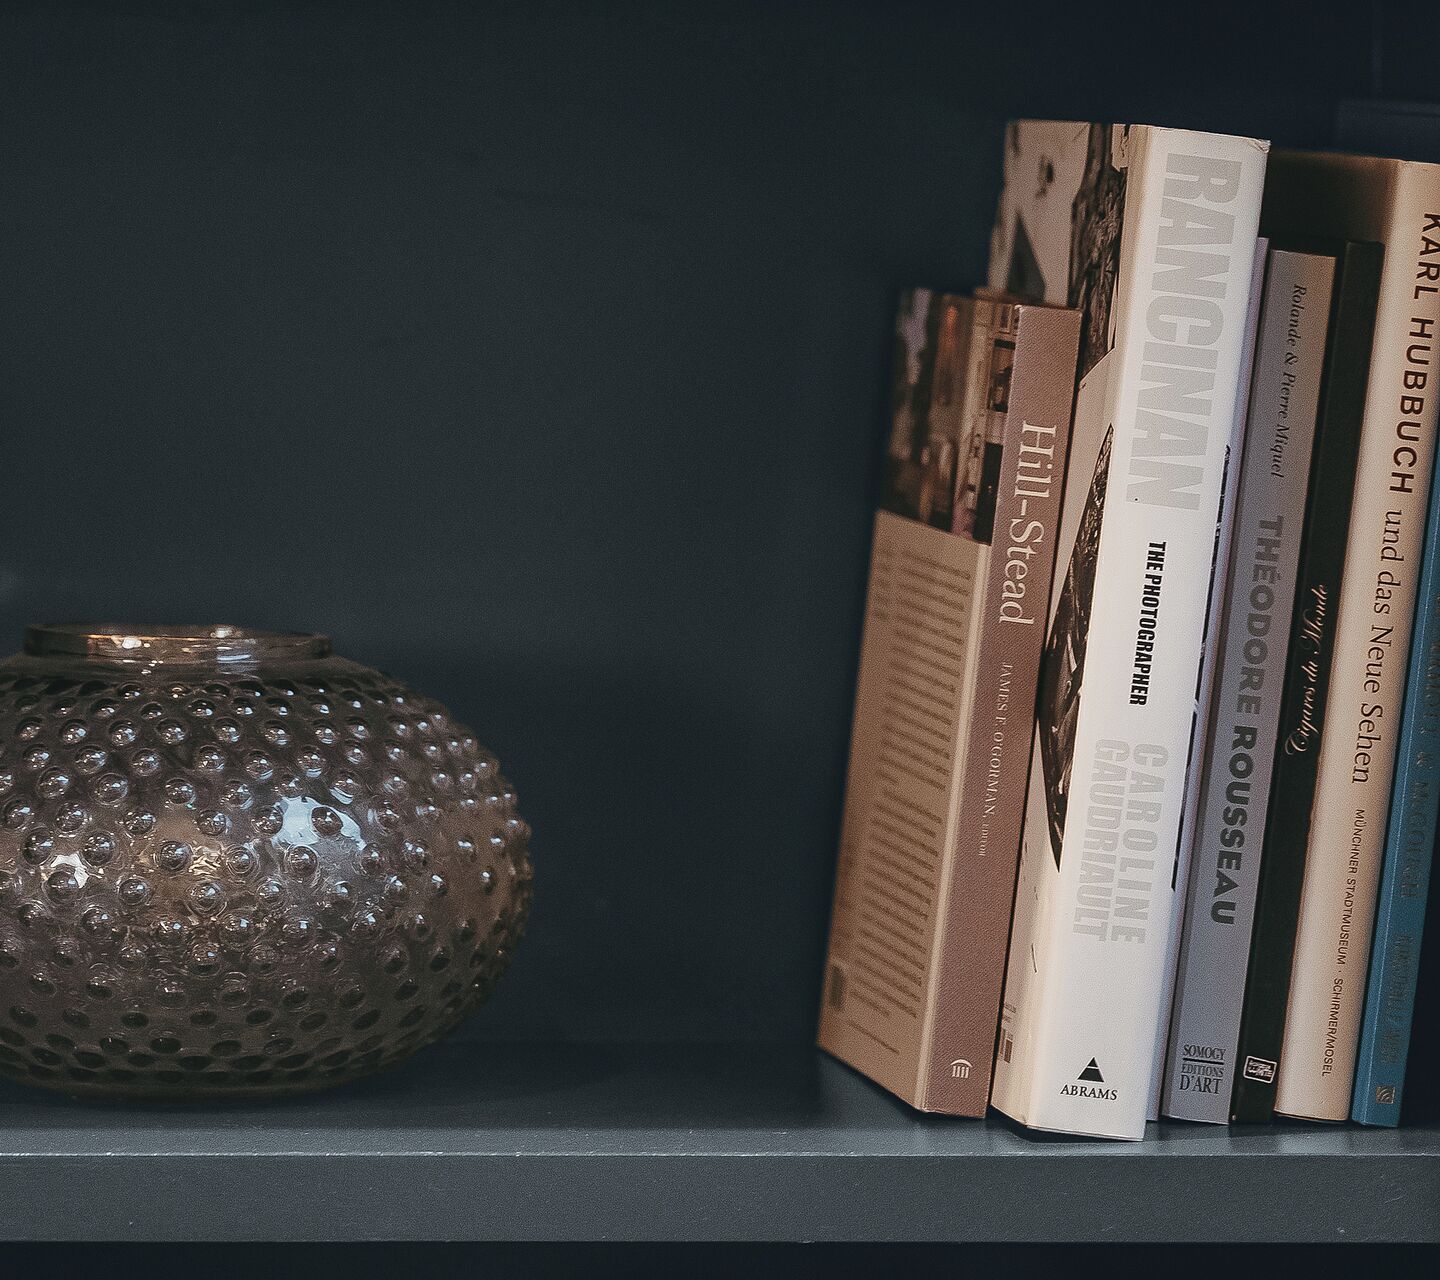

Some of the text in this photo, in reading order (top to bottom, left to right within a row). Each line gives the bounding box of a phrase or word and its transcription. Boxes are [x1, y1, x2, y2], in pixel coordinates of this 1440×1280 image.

[1125, 152, 1243, 511] RANCINAN
[1270, 283, 1308, 478] Rolande & Pierre Miquel
[998, 419, 1057, 626] Hill-Stead
[1352, 212, 1440, 784] KARL HUBBUCH und das Neue Sehen
[996, 662, 1014, 711] JAMES
[1128, 541, 1167, 707] THE PHOTOGRAPHER
[1210, 515, 1284, 926] THÉODORE ROUSSEAU
[1284, 584, 1329, 756] Cigares du Monde
[1072, 738, 1132, 942] GAUDRIAULT
[1111, 743, 1170, 945] CAROLINE
[1321, 809, 1366, 1078] MÜNCHNER STADTMUSEUM SCHIRMER/MOSEL
[1060, 1084, 1118, 1101] ABRAMS
[1179, 1078, 1222, 1095] D'ART
[1182, 1043, 1226, 1061] SOMOGY
